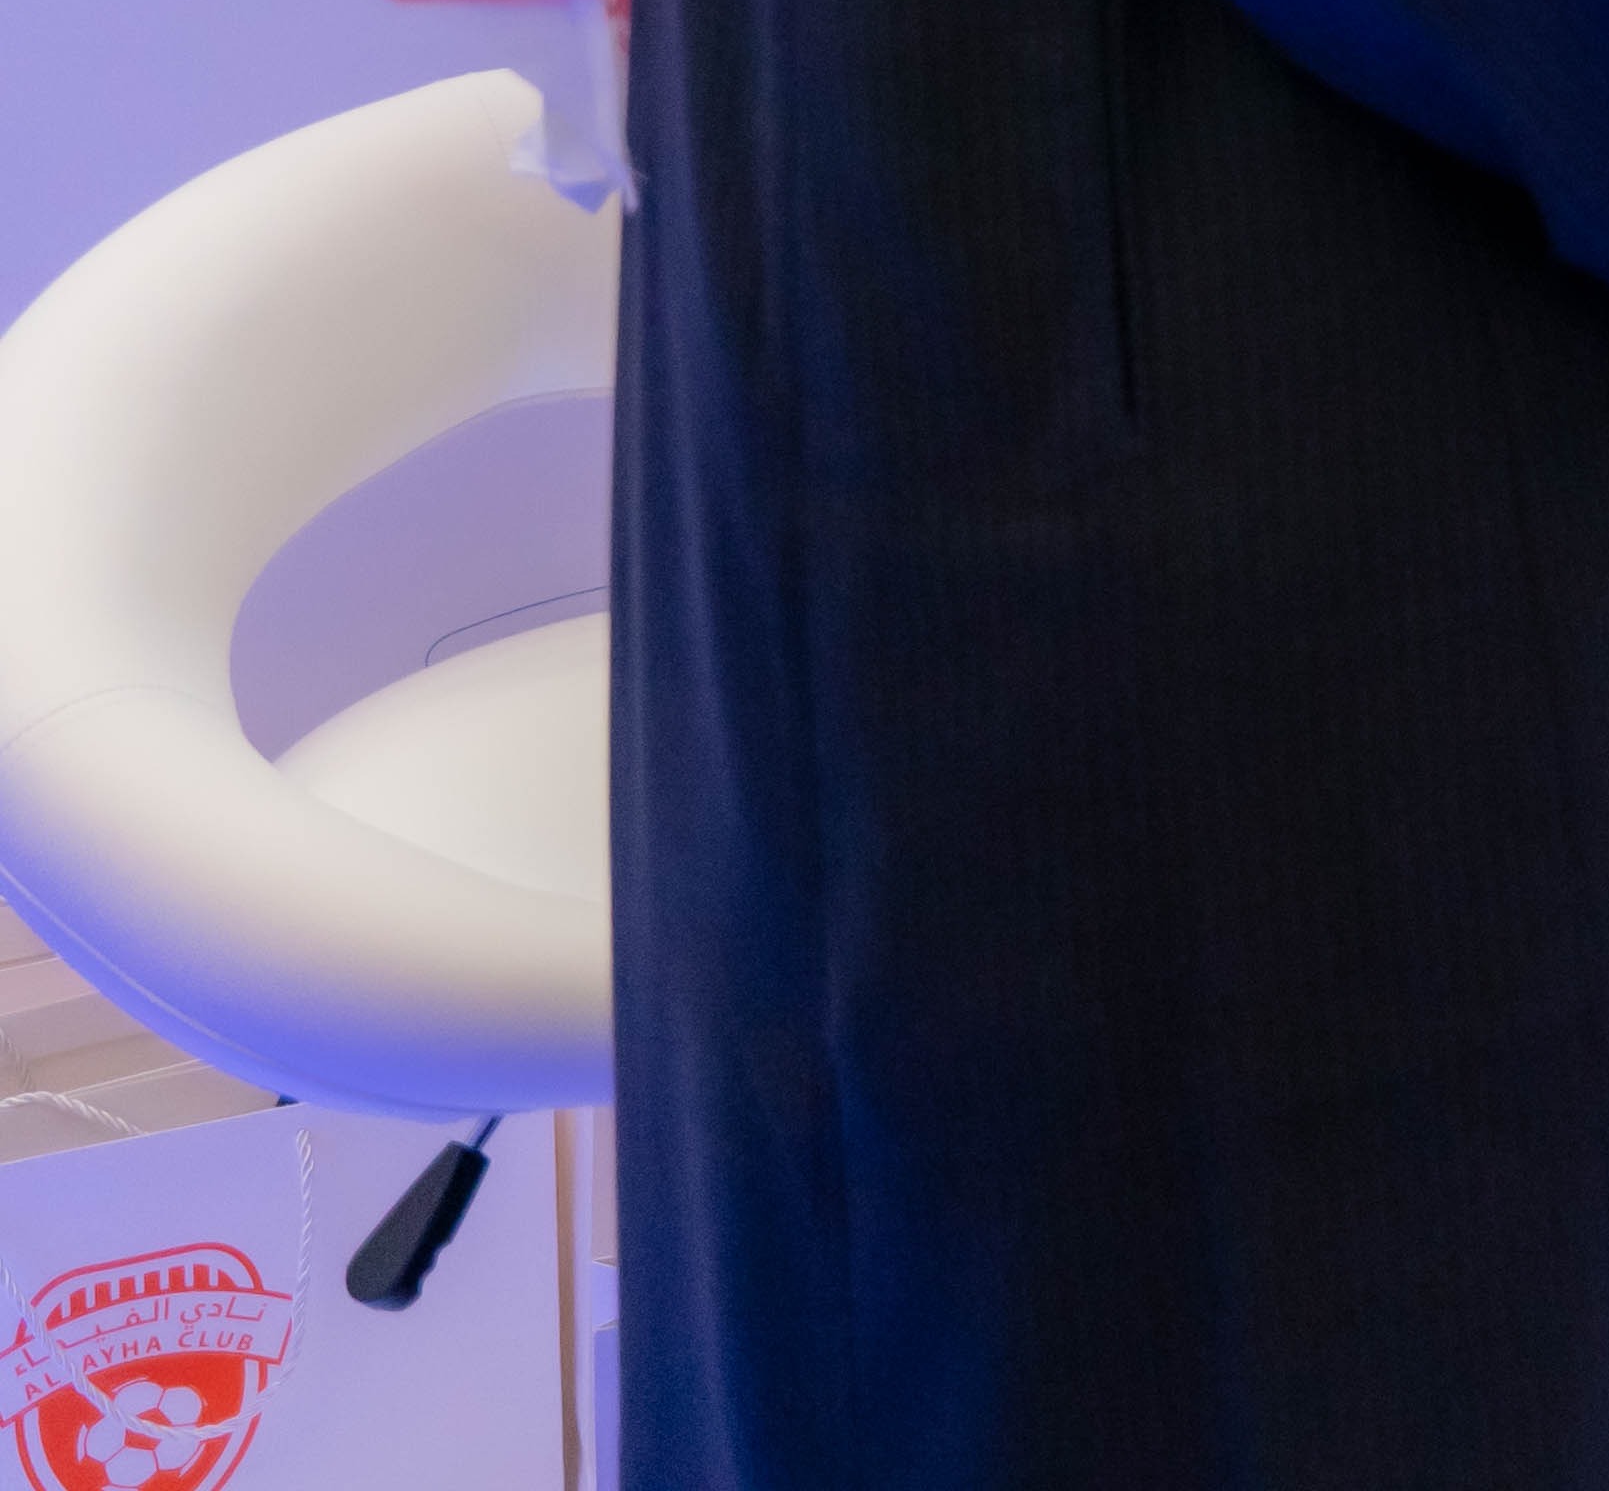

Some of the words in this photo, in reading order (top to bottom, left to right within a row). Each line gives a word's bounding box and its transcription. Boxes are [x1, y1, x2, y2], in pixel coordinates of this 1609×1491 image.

[179, 1295, 269, 1331] نادي
[23, 1335, 163, 1402] ALAYHA
[176, 1328, 255, 1352] CLUB
